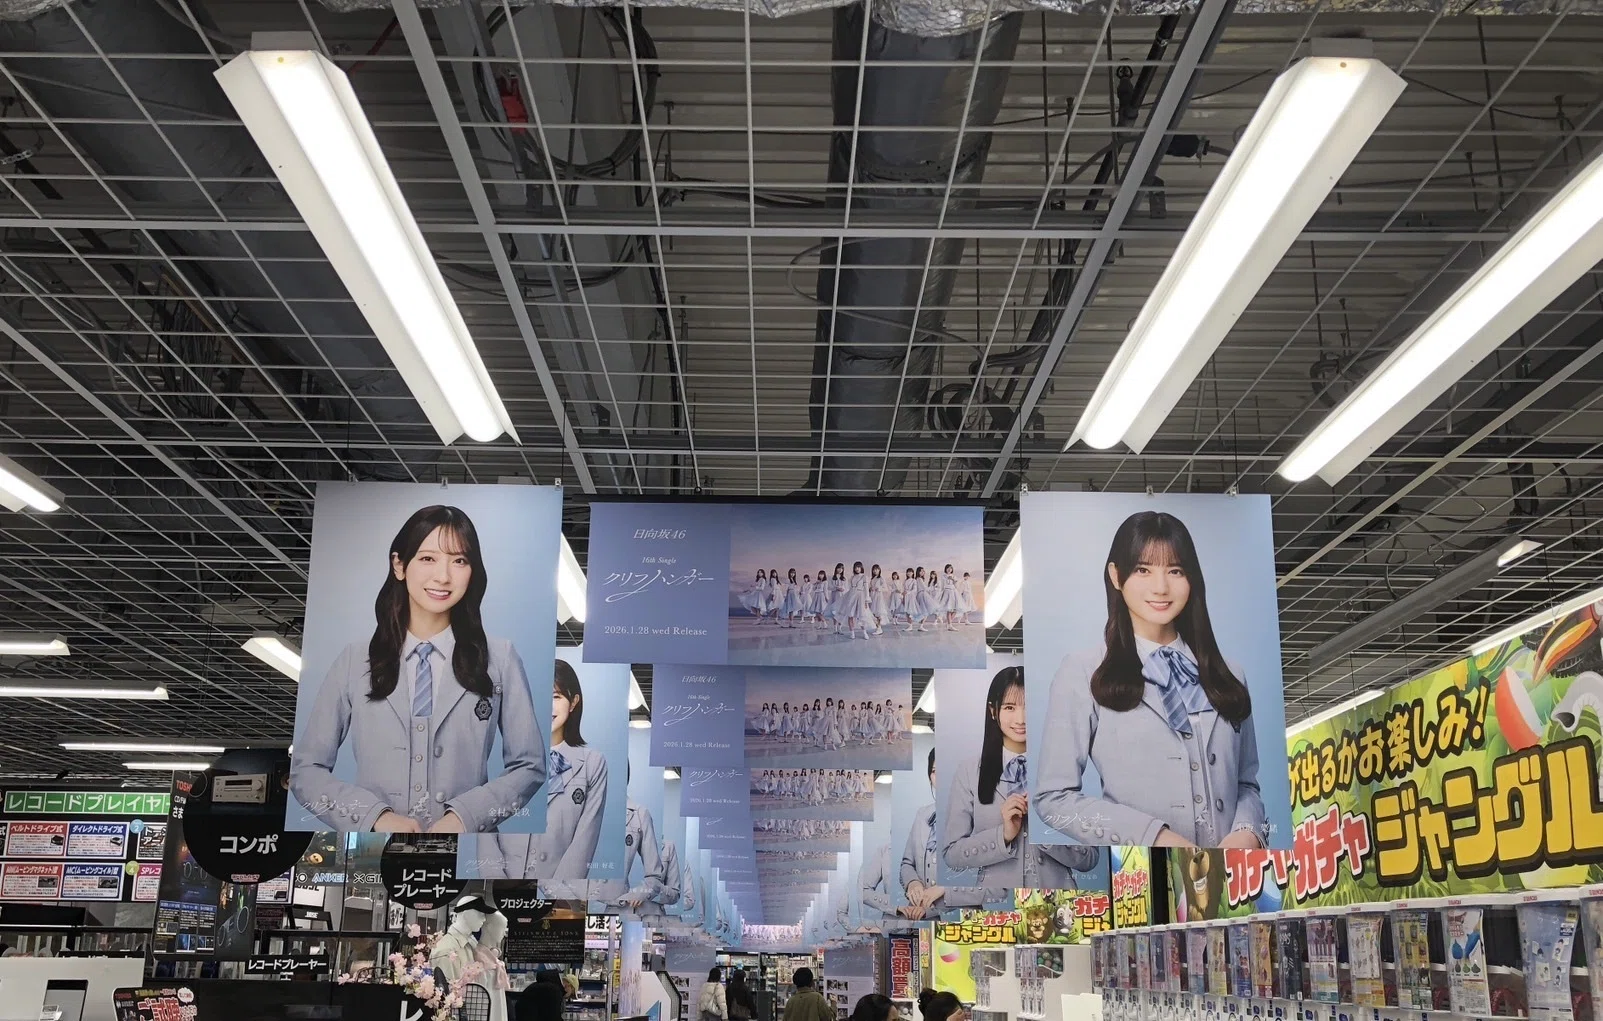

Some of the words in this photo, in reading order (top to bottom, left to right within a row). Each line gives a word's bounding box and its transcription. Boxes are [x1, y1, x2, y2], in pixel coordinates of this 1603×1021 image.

[633, 528, 686, 540] 日向坂46
[642, 556, 656, 564] 16th
[658, 557, 677, 566] Single
[603, 569, 714, 603] クリフハンガー
[604, 625, 649, 635] 2026.1.28
[652, 626, 670, 636] wed
[672, 627, 708, 637] Release
[1374, 750, 1603, 885] ジャングル
[219, 833, 279, 855] コンポ
[402, 868, 453, 884] レコード
[393, 883, 459, 900] プレーヤー
[500, 898, 553, 910] プロジェクター
[944, 924, 1017, 943] ジャングル
[247, 958, 328, 971] レコードプレーヤー
